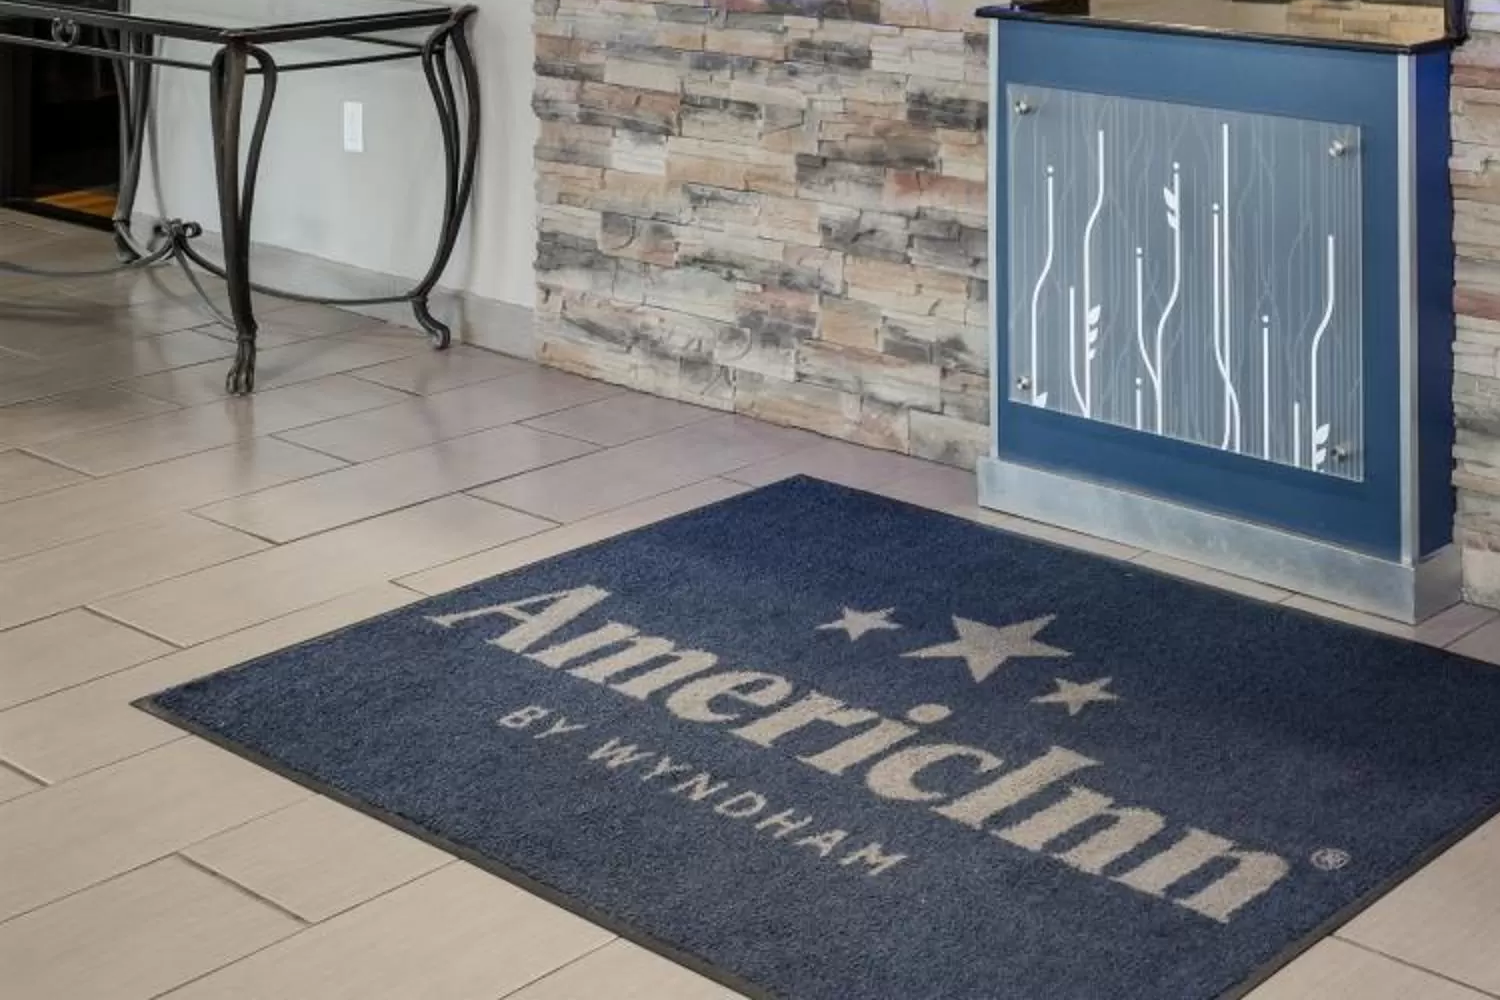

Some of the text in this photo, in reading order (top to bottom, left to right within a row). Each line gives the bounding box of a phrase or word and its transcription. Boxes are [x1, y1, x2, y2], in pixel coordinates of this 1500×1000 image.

[420, 584, 1291, 923] AmericInn
[499, 704, 908, 876] BY WYNDHAM
